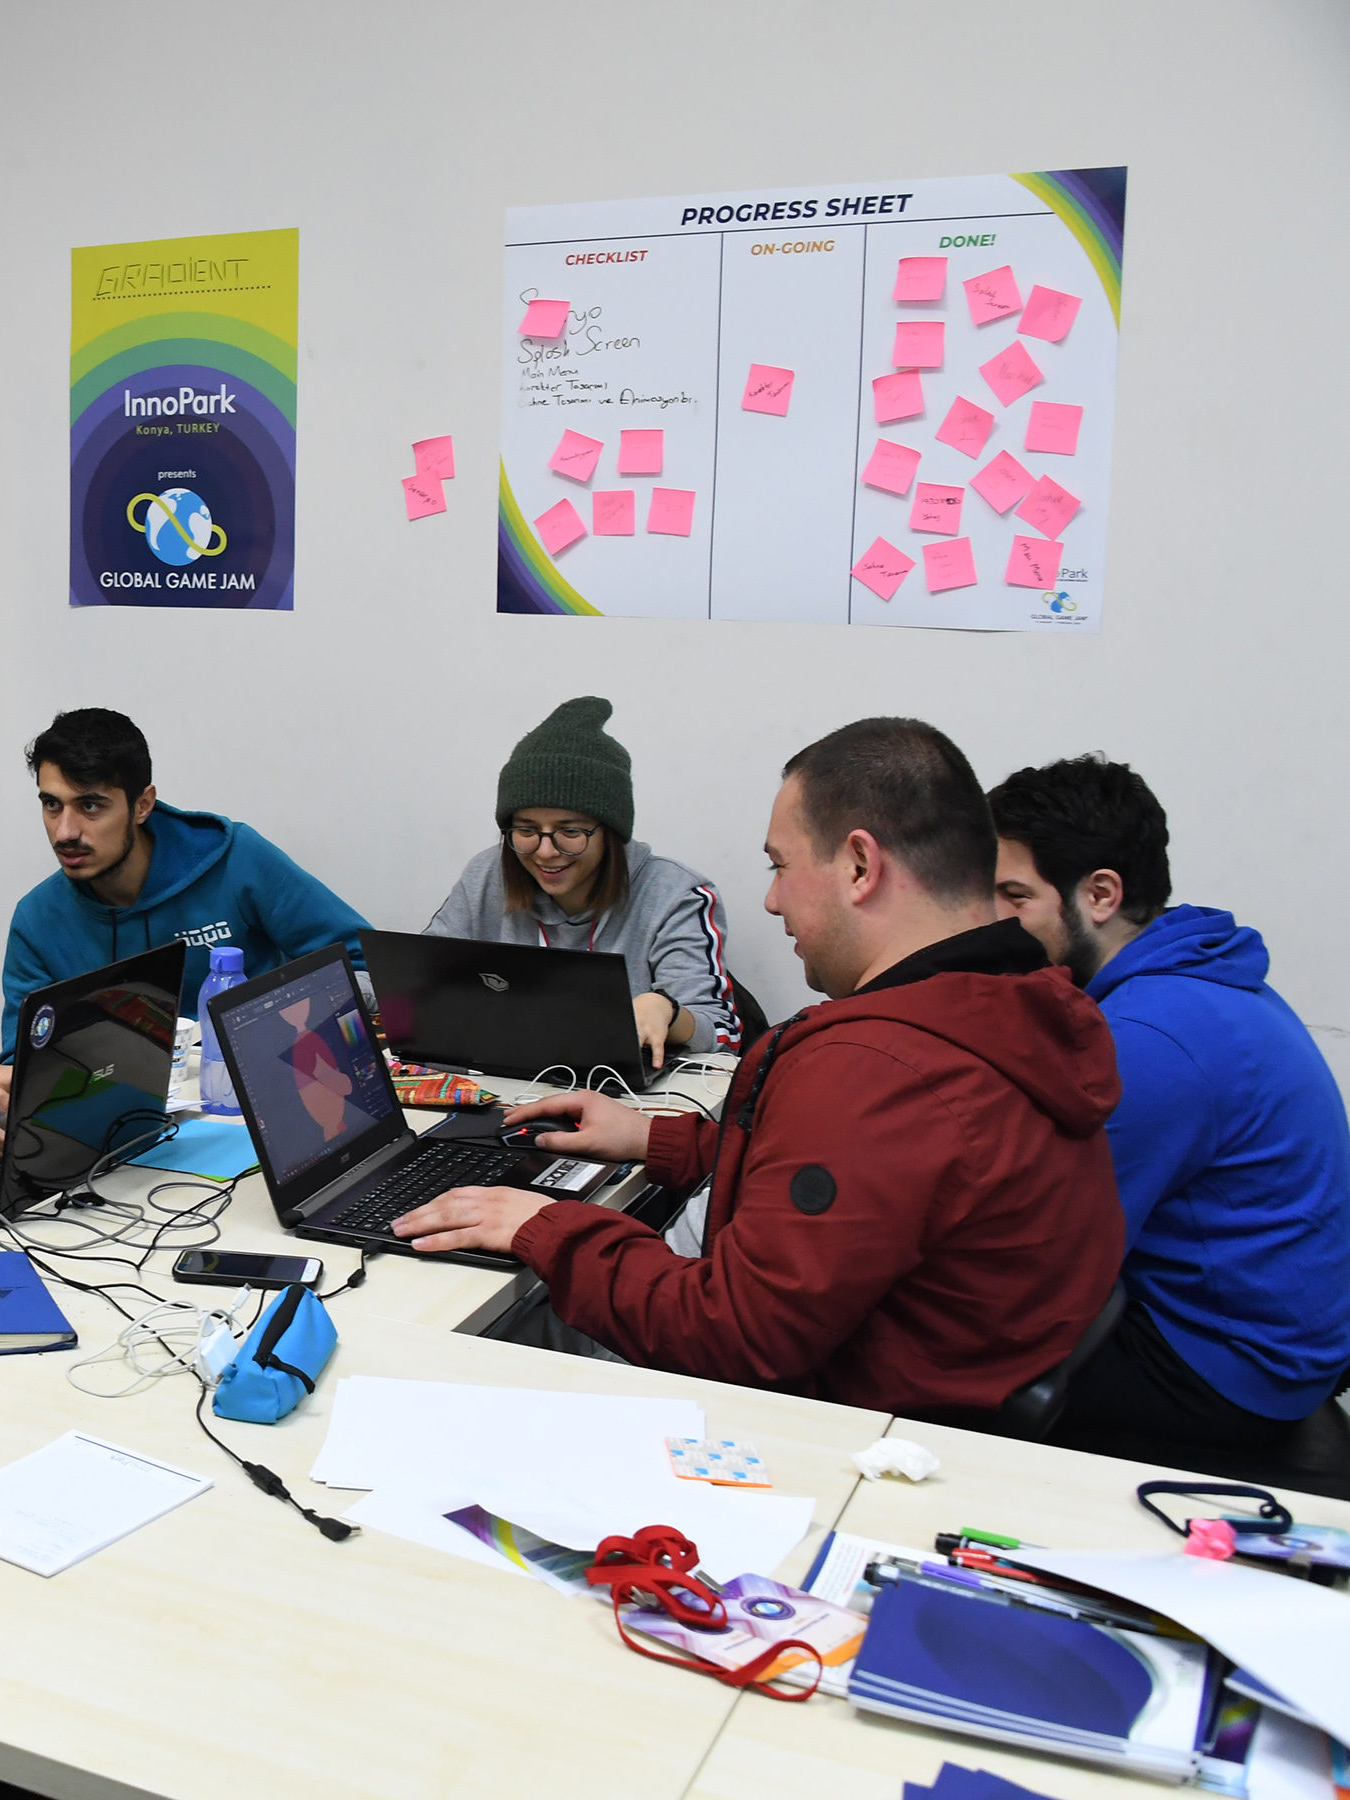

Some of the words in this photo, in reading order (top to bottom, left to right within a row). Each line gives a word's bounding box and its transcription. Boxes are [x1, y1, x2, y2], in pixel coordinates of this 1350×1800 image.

[681, 199, 818, 226] PROGRESS
[825, 194, 913, 217] SHEET
[751, 240, 835, 256] ON-GOING
[939, 234, 996, 249] DONE!
[565, 250, 648, 266] CHECKLIST
[124, 383, 237, 417] InnoPark
[136, 424, 173, 437] Konya,
[176, 422, 220, 434] TURKEY
[157, 469, 197, 481] presents
[100, 571, 162, 588] GLOBAL
[165, 572, 217, 589] GAME
[219, 573, 256, 590] JAM
